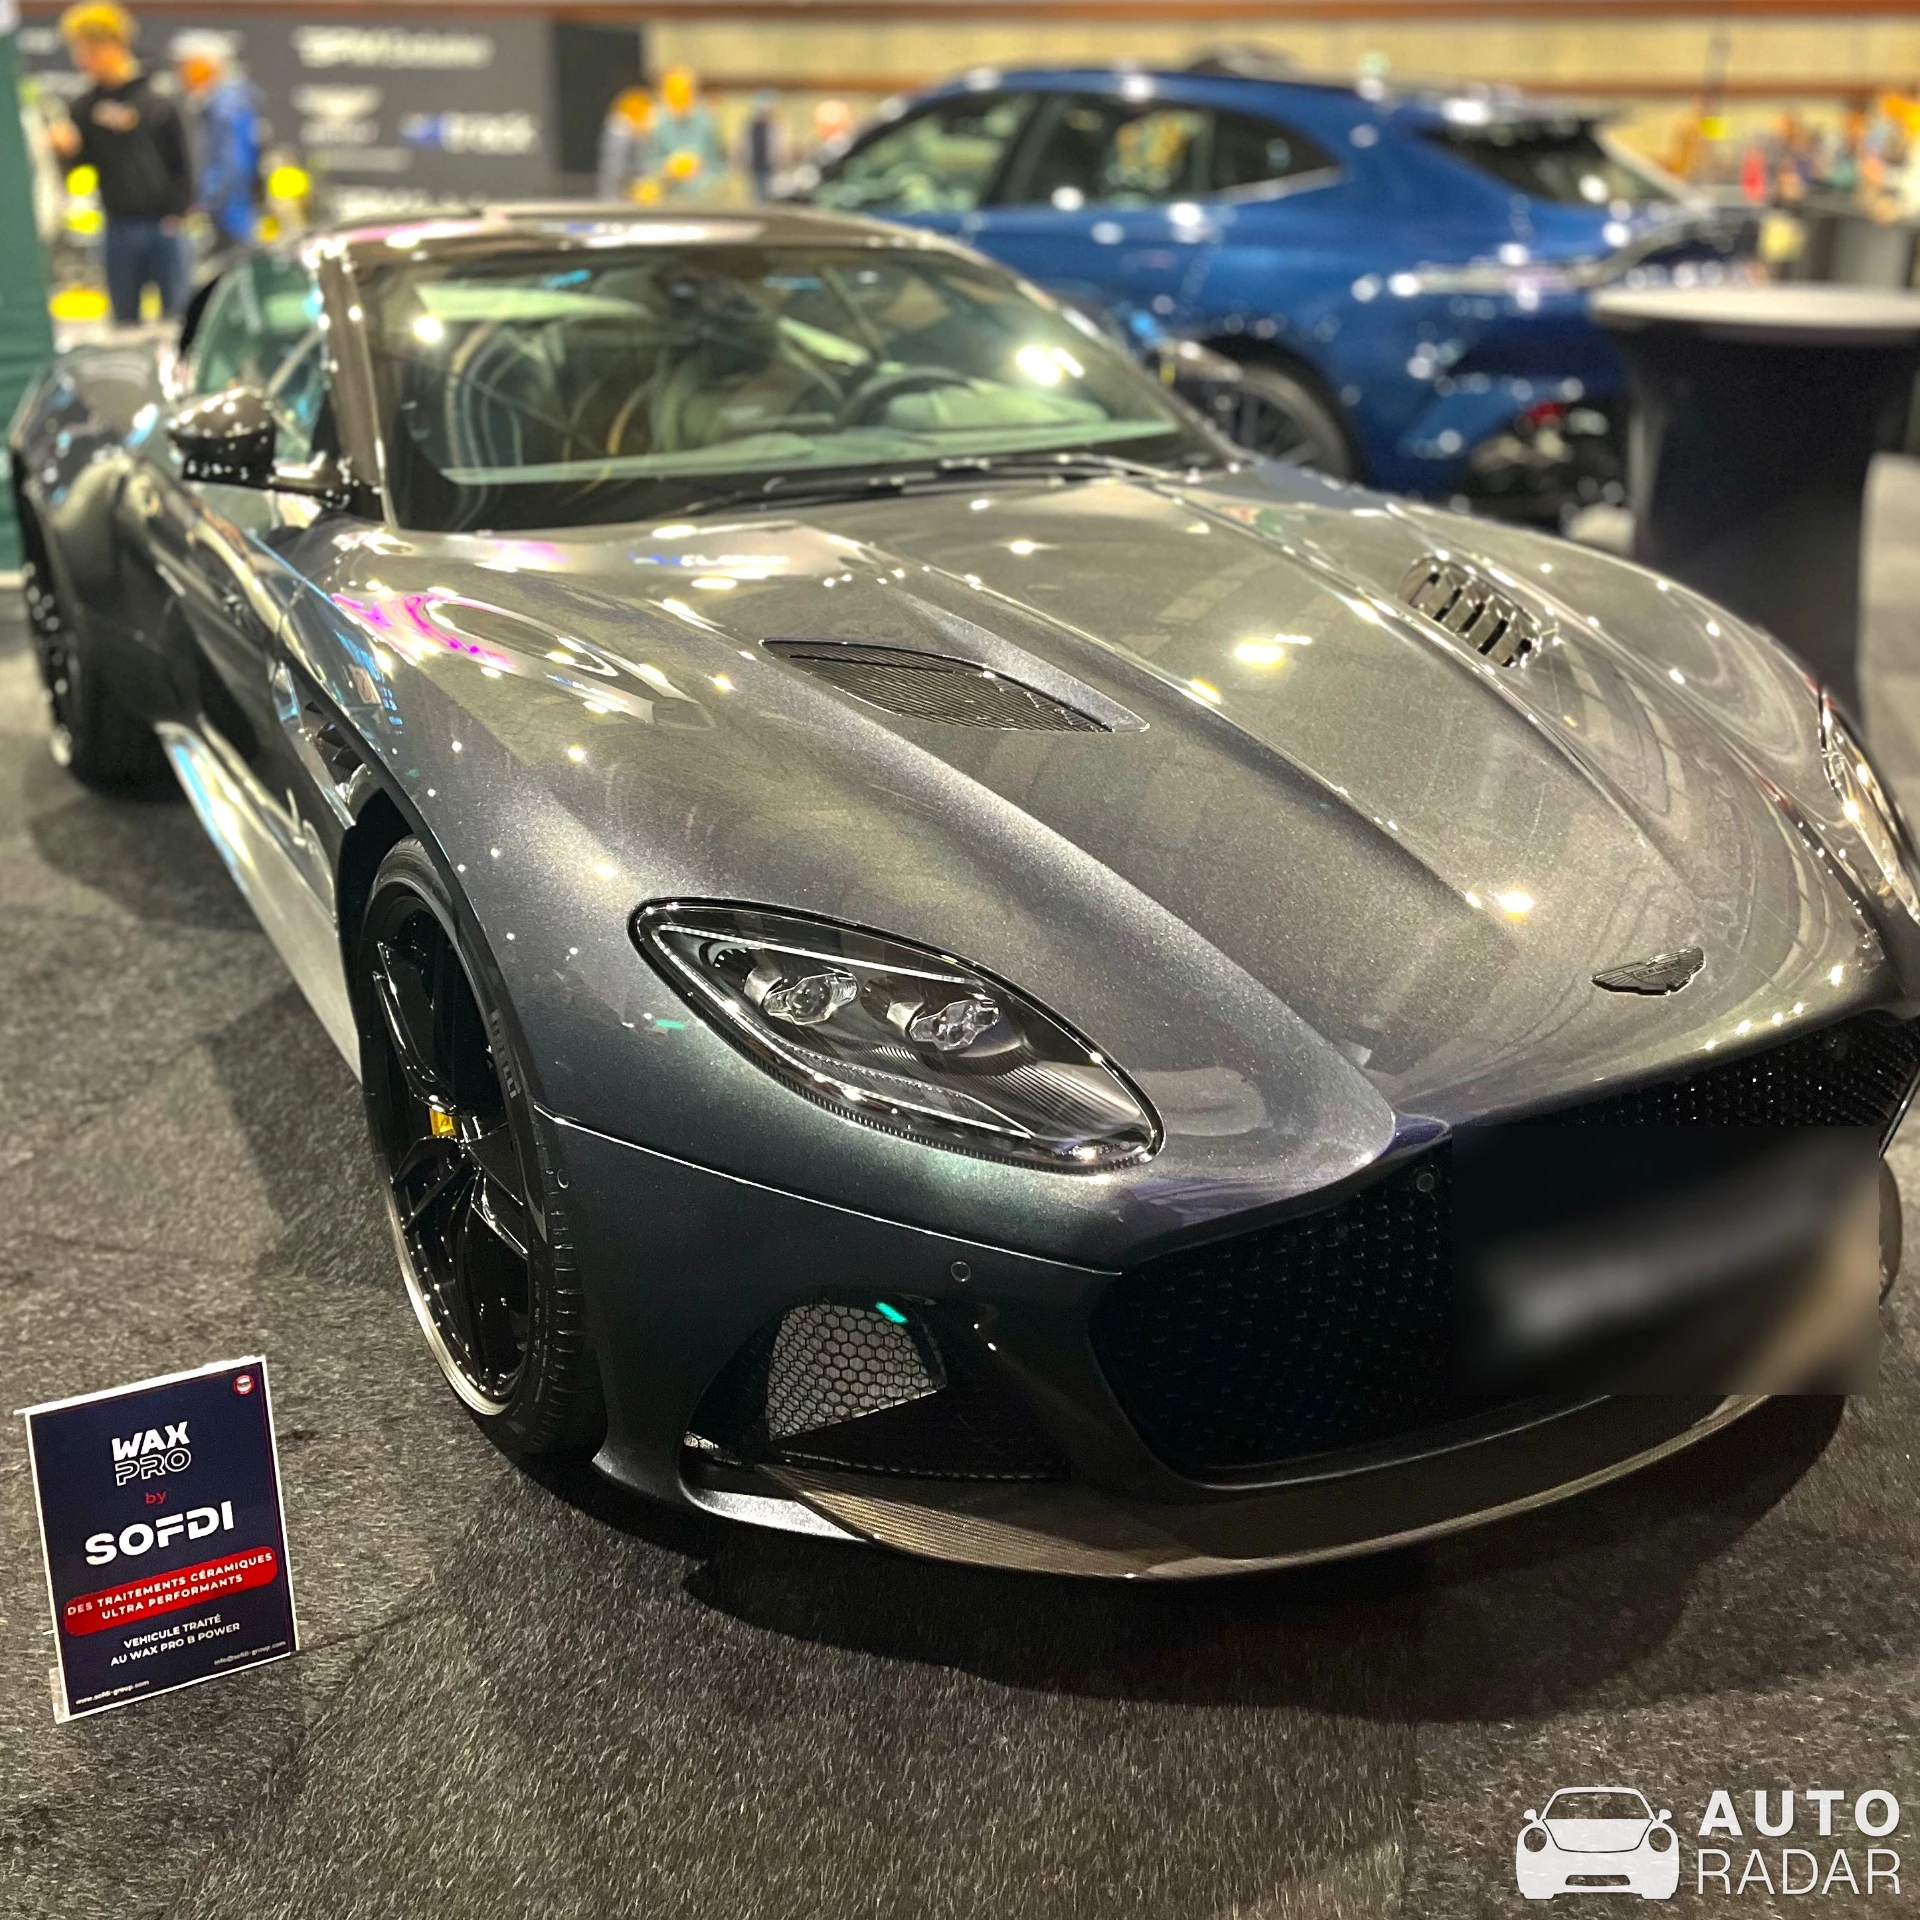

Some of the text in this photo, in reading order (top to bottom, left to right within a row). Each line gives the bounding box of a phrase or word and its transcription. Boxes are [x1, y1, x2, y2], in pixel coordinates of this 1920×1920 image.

[111, 1421, 190, 1461] WAX
[115, 1447, 192, 1487] PRO
[145, 1491, 167, 1505] by
[85, 1500, 234, 1566] SOFDI
[67, 1552, 273, 1616] DES TRAITEMENTS CÉRAMIQUES
[101, 1574, 243, 1620] ULTRA PERFORMANTS
[110, 1654, 127, 1667] AU
[129, 1645, 158, 1661] WAX
[160, 1638, 185, 1652] PRO
[197, 1622, 241, 1641] POWER
[123, 1613, 221, 1649] VEHICULE TRAITÉ
